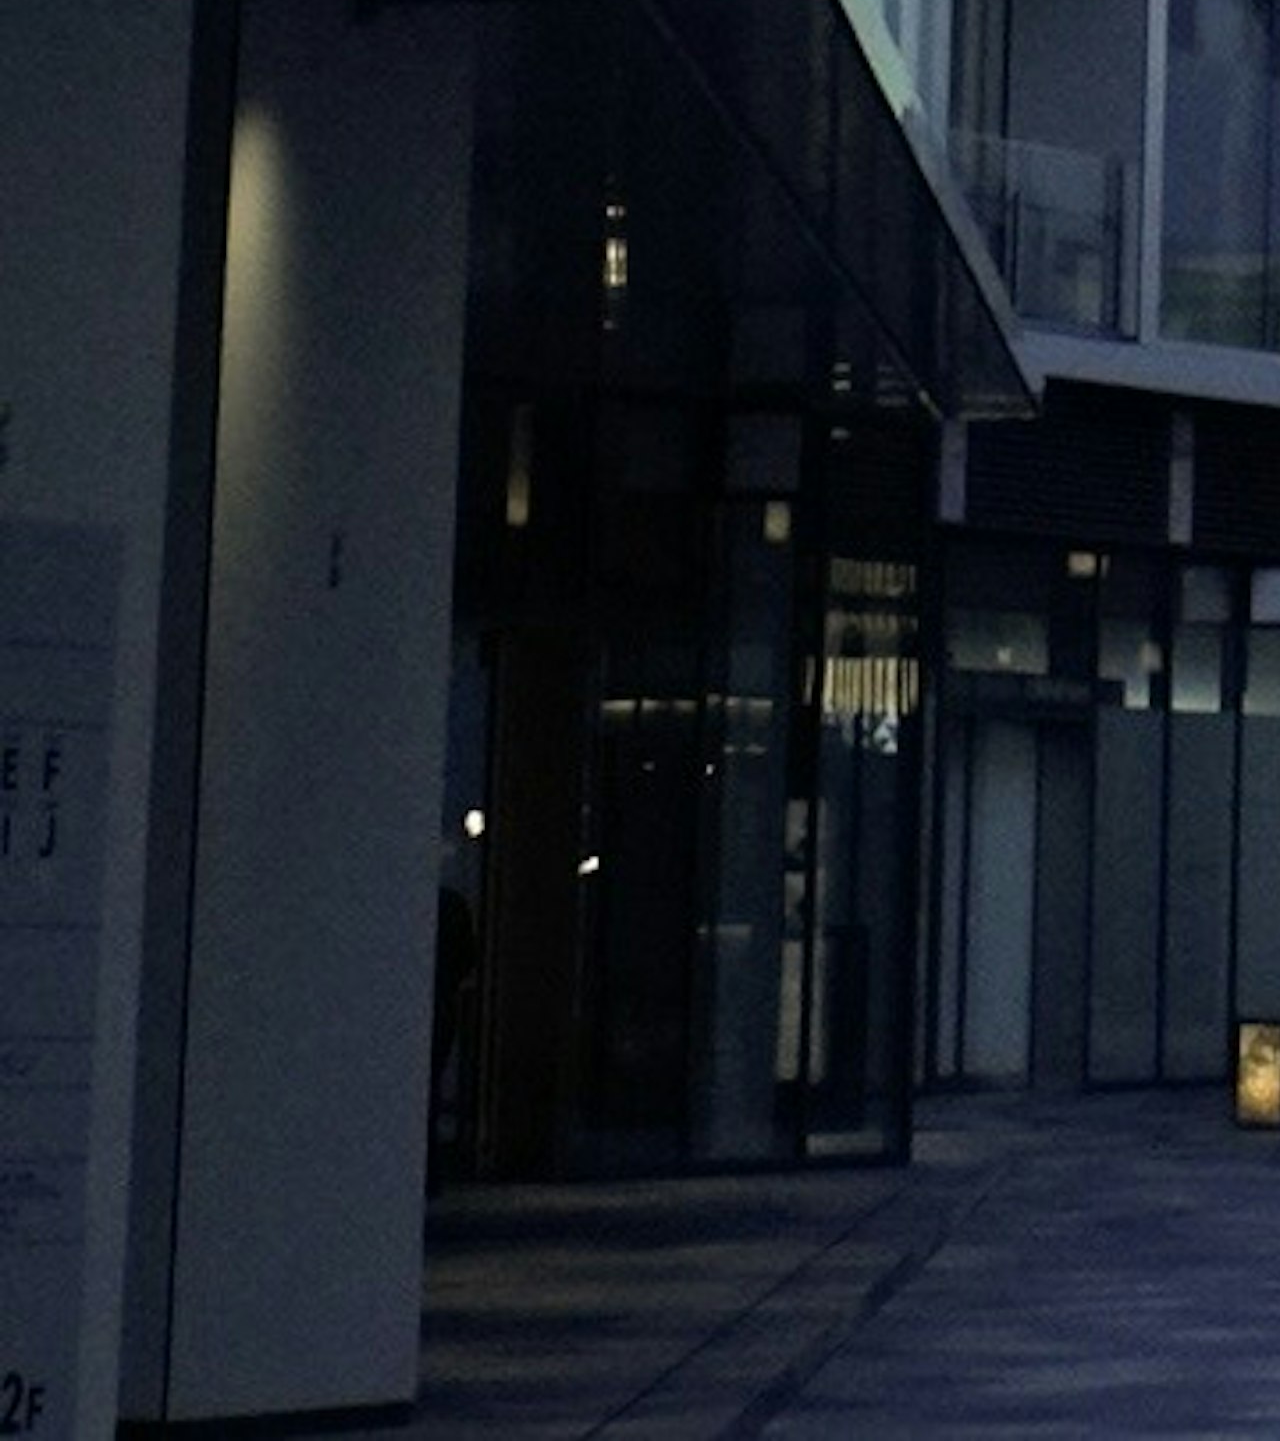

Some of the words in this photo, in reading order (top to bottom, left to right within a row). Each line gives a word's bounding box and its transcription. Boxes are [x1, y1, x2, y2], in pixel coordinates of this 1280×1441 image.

[3, 749, 20, 790] E
[43, 749, 61, 790] F
[38, 815, 56, 857] J
[0, 1370, 45, 1434] 2F
